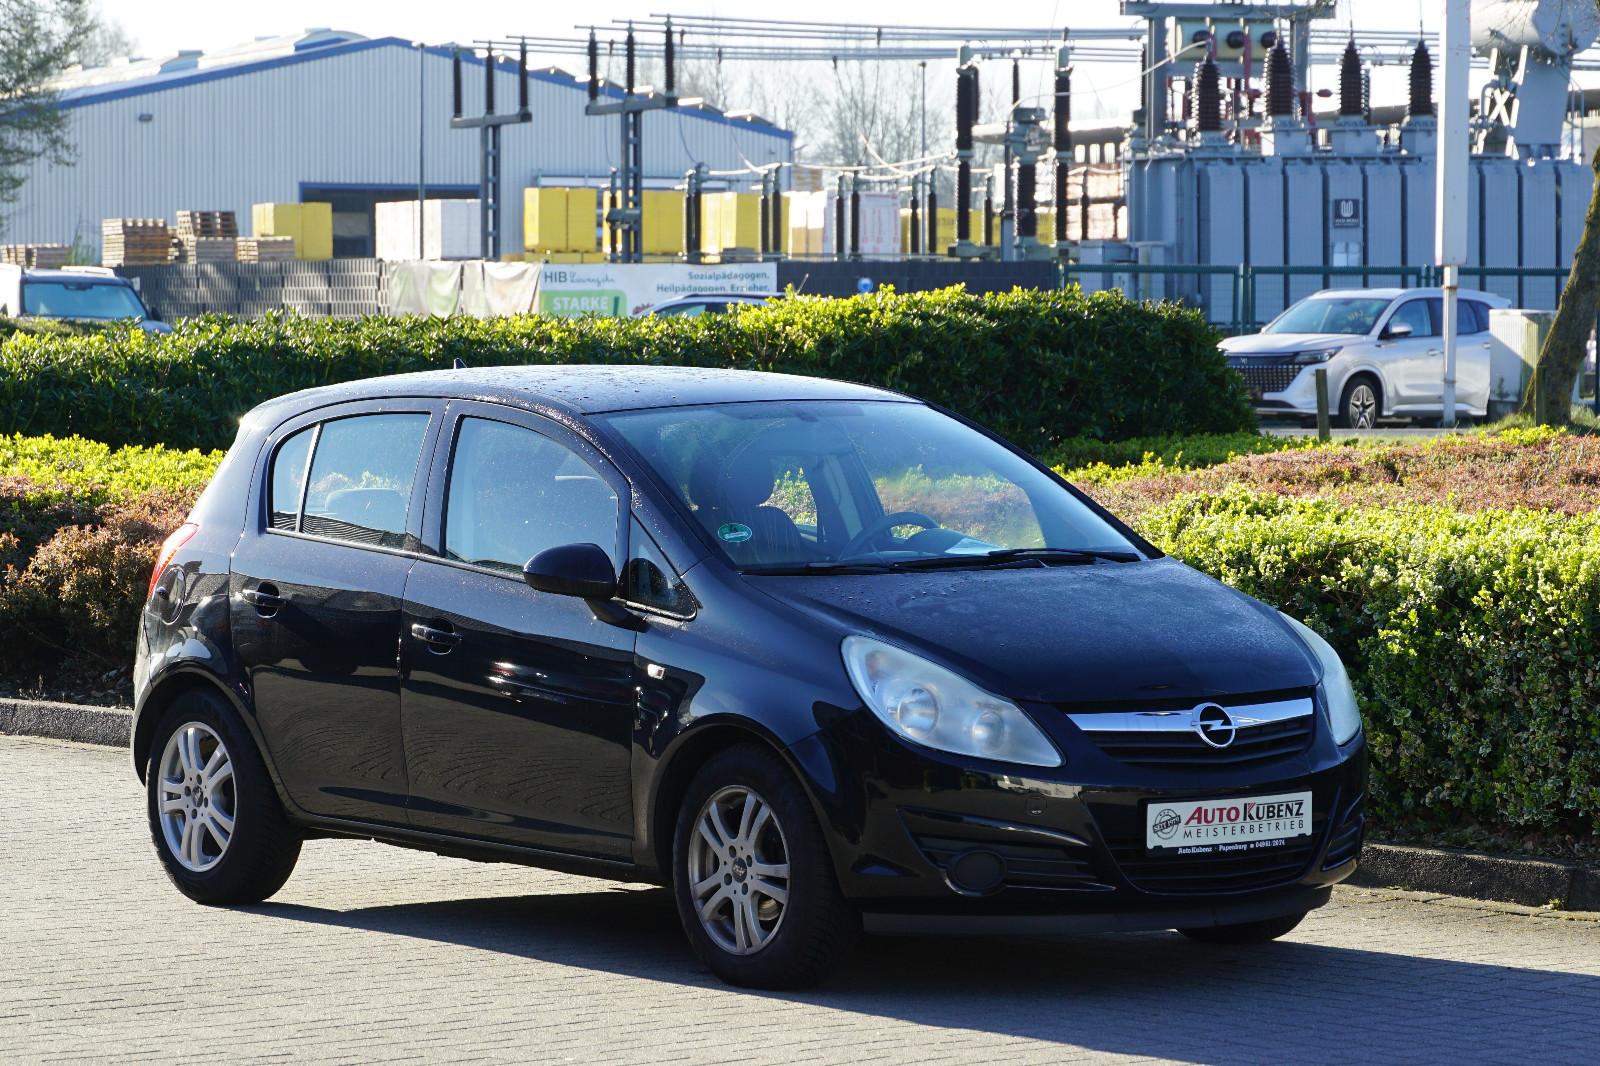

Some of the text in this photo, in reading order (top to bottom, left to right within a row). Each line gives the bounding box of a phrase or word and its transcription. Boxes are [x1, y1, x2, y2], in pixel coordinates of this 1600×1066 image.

[544, 271, 567, 283] HIB
[553, 296, 608, 311] STARKE
[1184, 806, 1240, 826] AUTO
[1184, 820, 1304, 839] MEISTERBETRIEB
